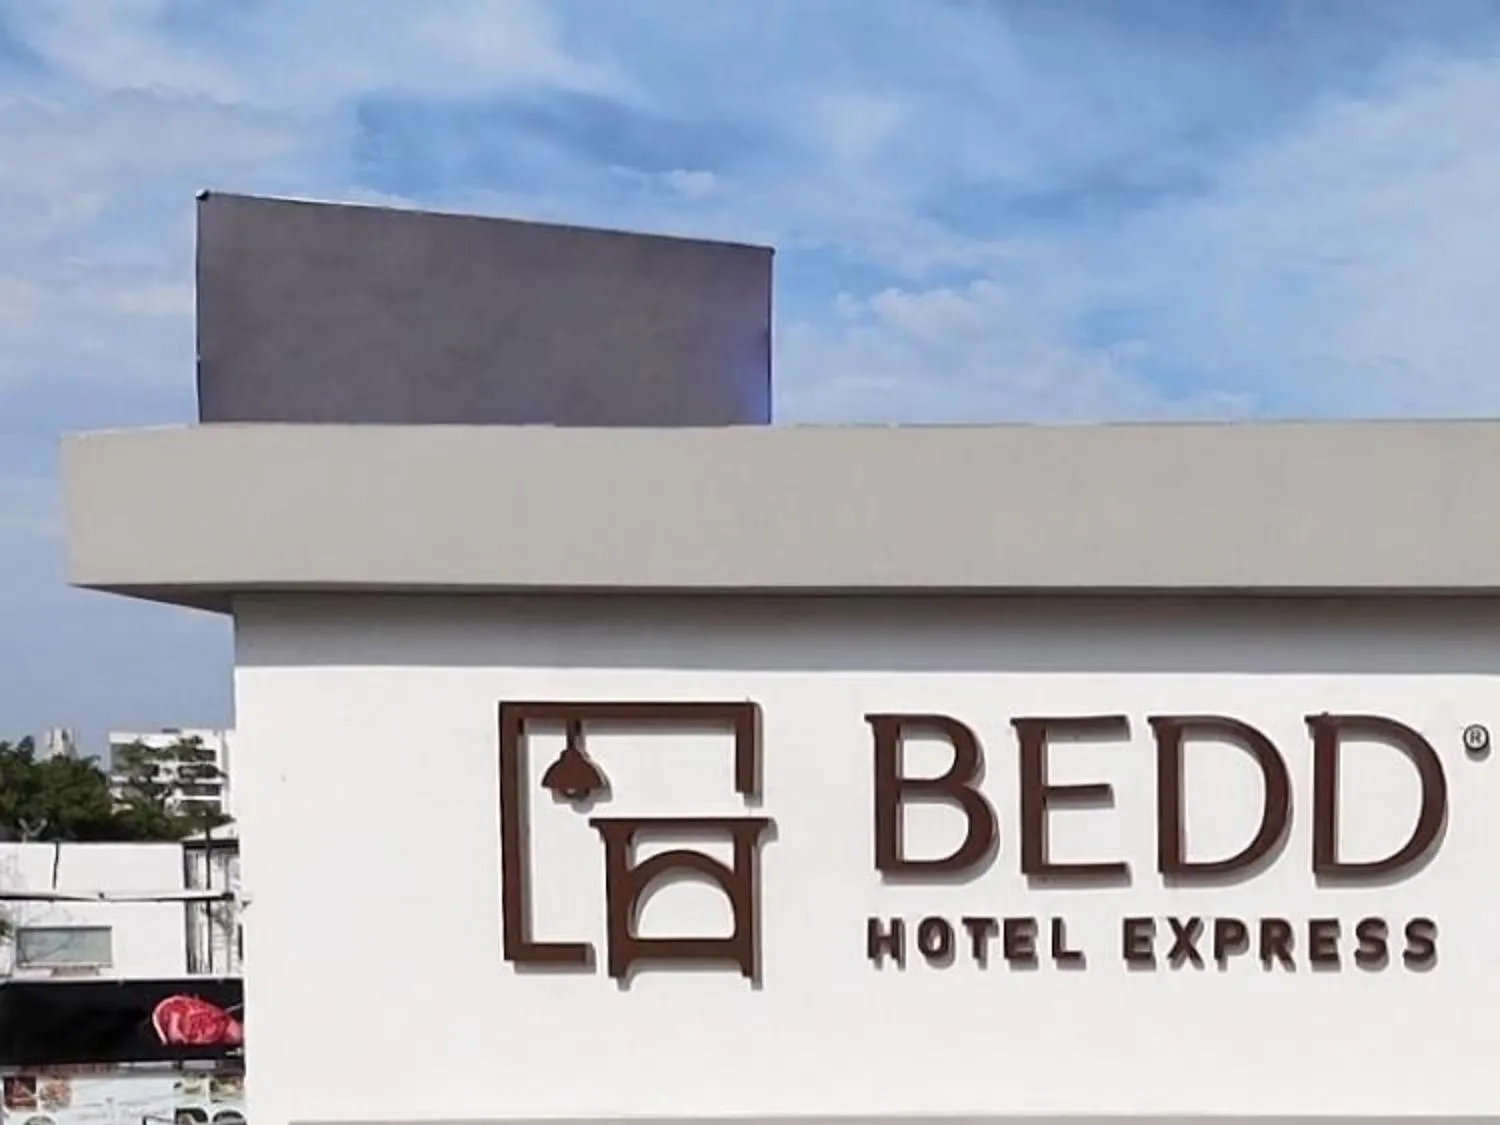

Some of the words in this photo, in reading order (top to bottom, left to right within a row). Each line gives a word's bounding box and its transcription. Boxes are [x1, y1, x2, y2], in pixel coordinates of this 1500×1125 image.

[865, 713, 1448, 880] BEDD
[867, 916, 1082, 965] HOTEL
[1123, 917, 1436, 968] EXPRESS
